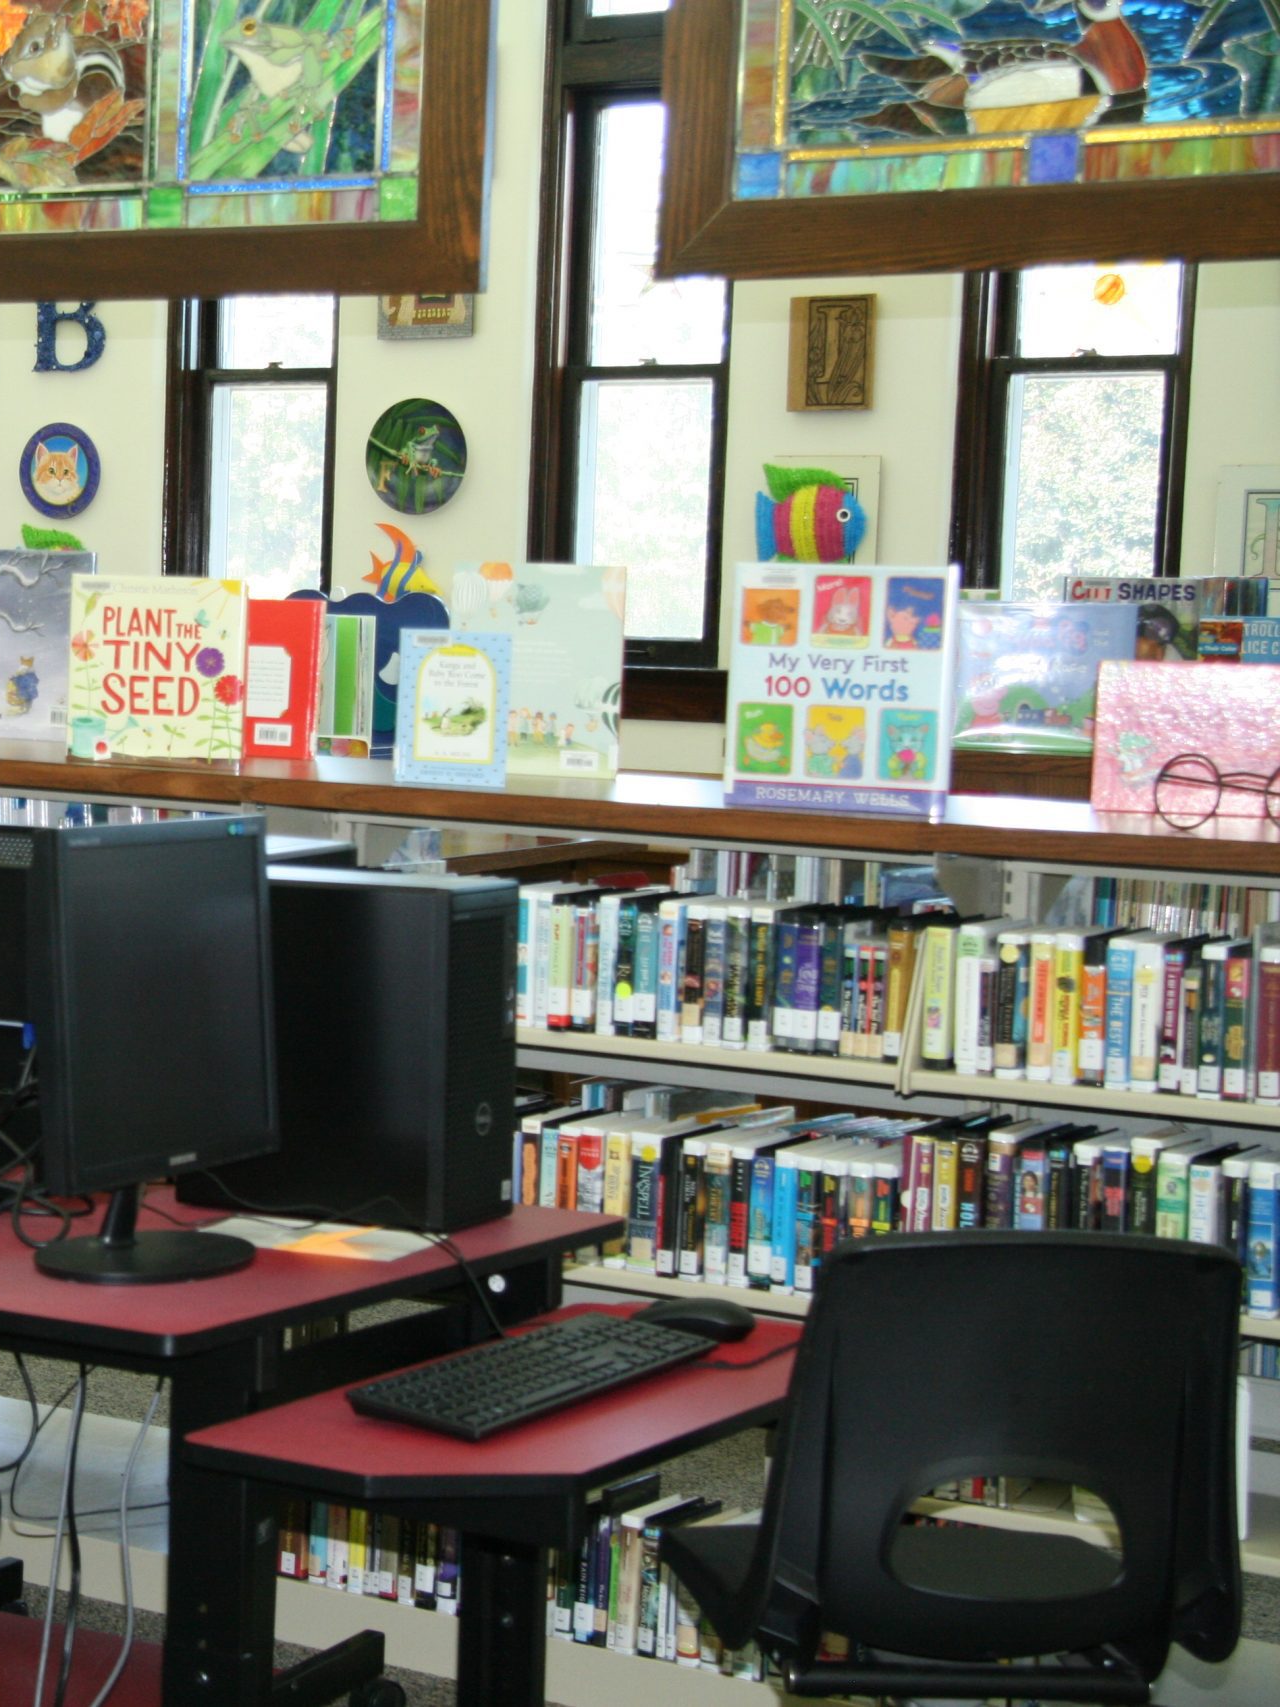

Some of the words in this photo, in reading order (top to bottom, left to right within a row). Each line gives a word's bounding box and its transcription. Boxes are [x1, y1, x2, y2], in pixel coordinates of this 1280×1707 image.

[1117, 582, 1197, 601] SHAPES
[103, 606, 177, 638] PLANT
[175, 623, 202, 640] THE
[103, 639, 201, 672] TINY
[768, 653, 800, 673] My
[807, 654, 854, 675] Very
[862, 655, 909, 673] First
[101, 672, 201, 717] SEED
[765, 675, 812, 697] 100
[821, 677, 910, 702] Words
[755, 786, 845, 805] ROSEMARY
[853, 791, 911, 807] WELLS
[1110, 997, 1124, 1016] THE
[1109, 1020, 1122, 1046] BEST
[635, 1165, 655, 1219] INKSPELL
